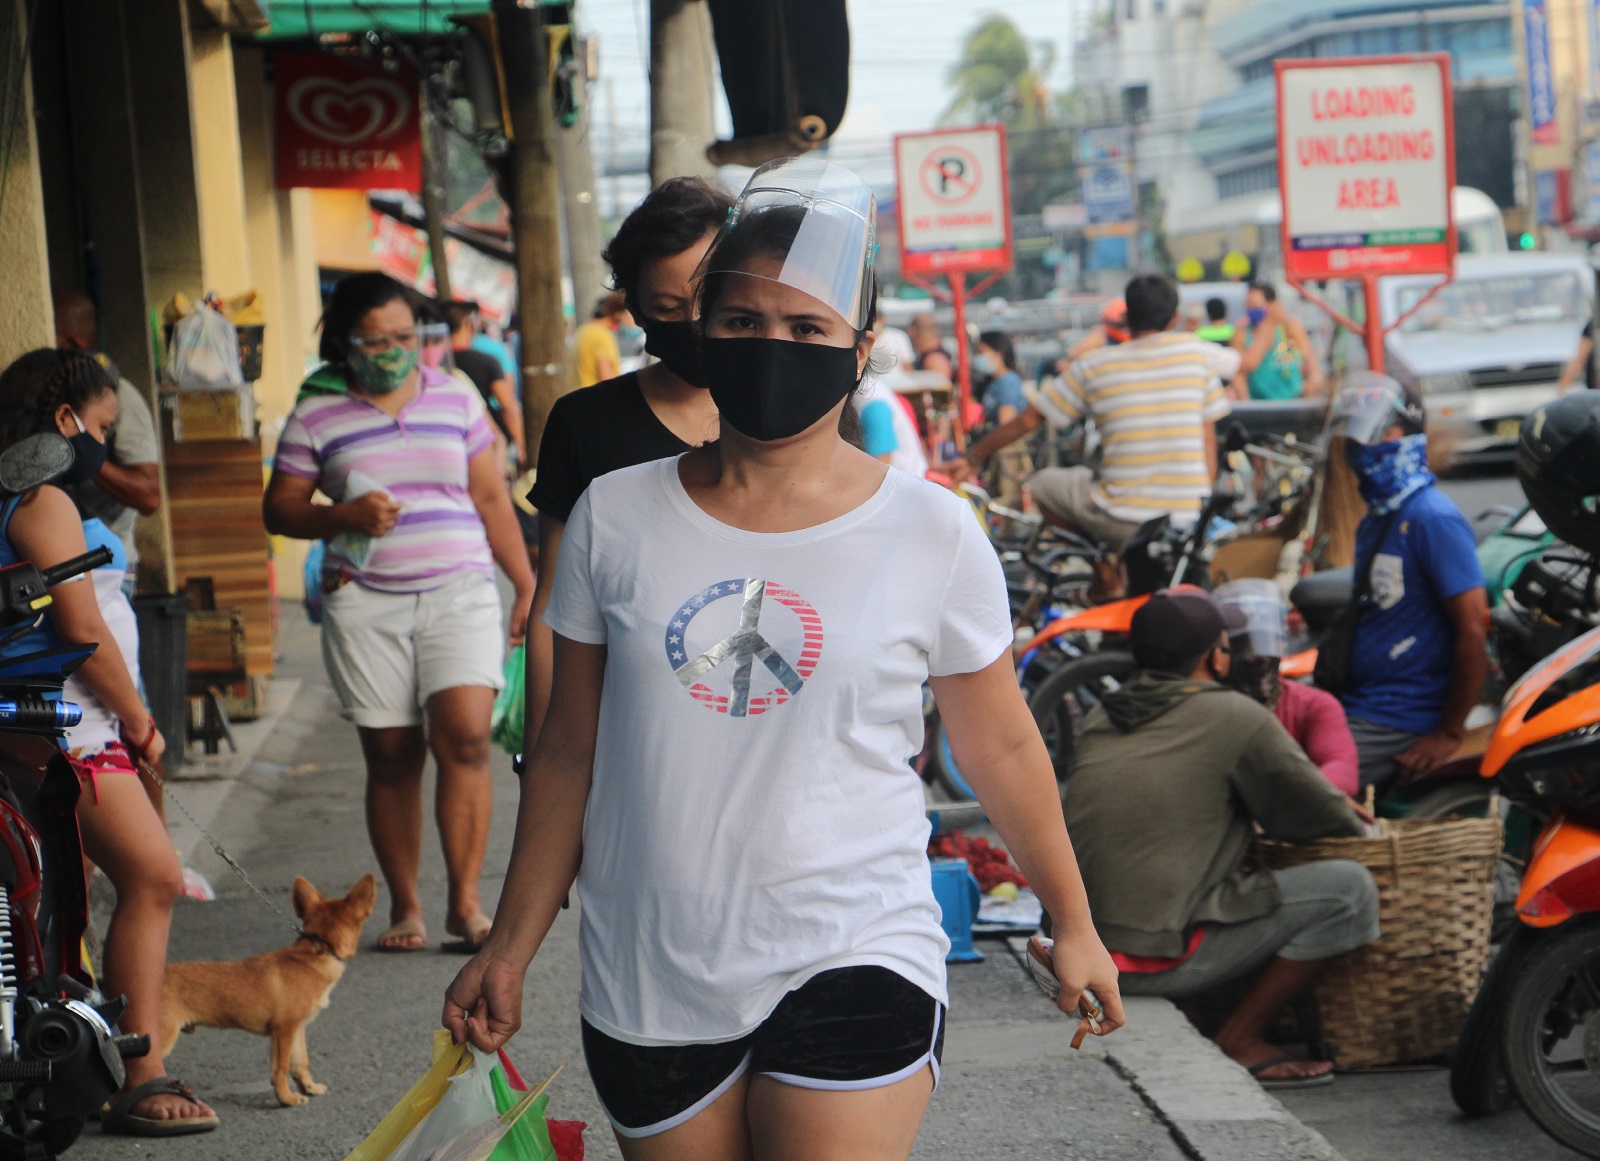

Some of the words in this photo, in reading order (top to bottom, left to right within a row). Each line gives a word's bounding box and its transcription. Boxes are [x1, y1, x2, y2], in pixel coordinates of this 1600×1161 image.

[1311, 85, 1416, 121] LOADING
[297, 148, 403, 170] SELECTA
[1297, 130, 1434, 167] UNLOADING
[1336, 178, 1400, 209] AREA
